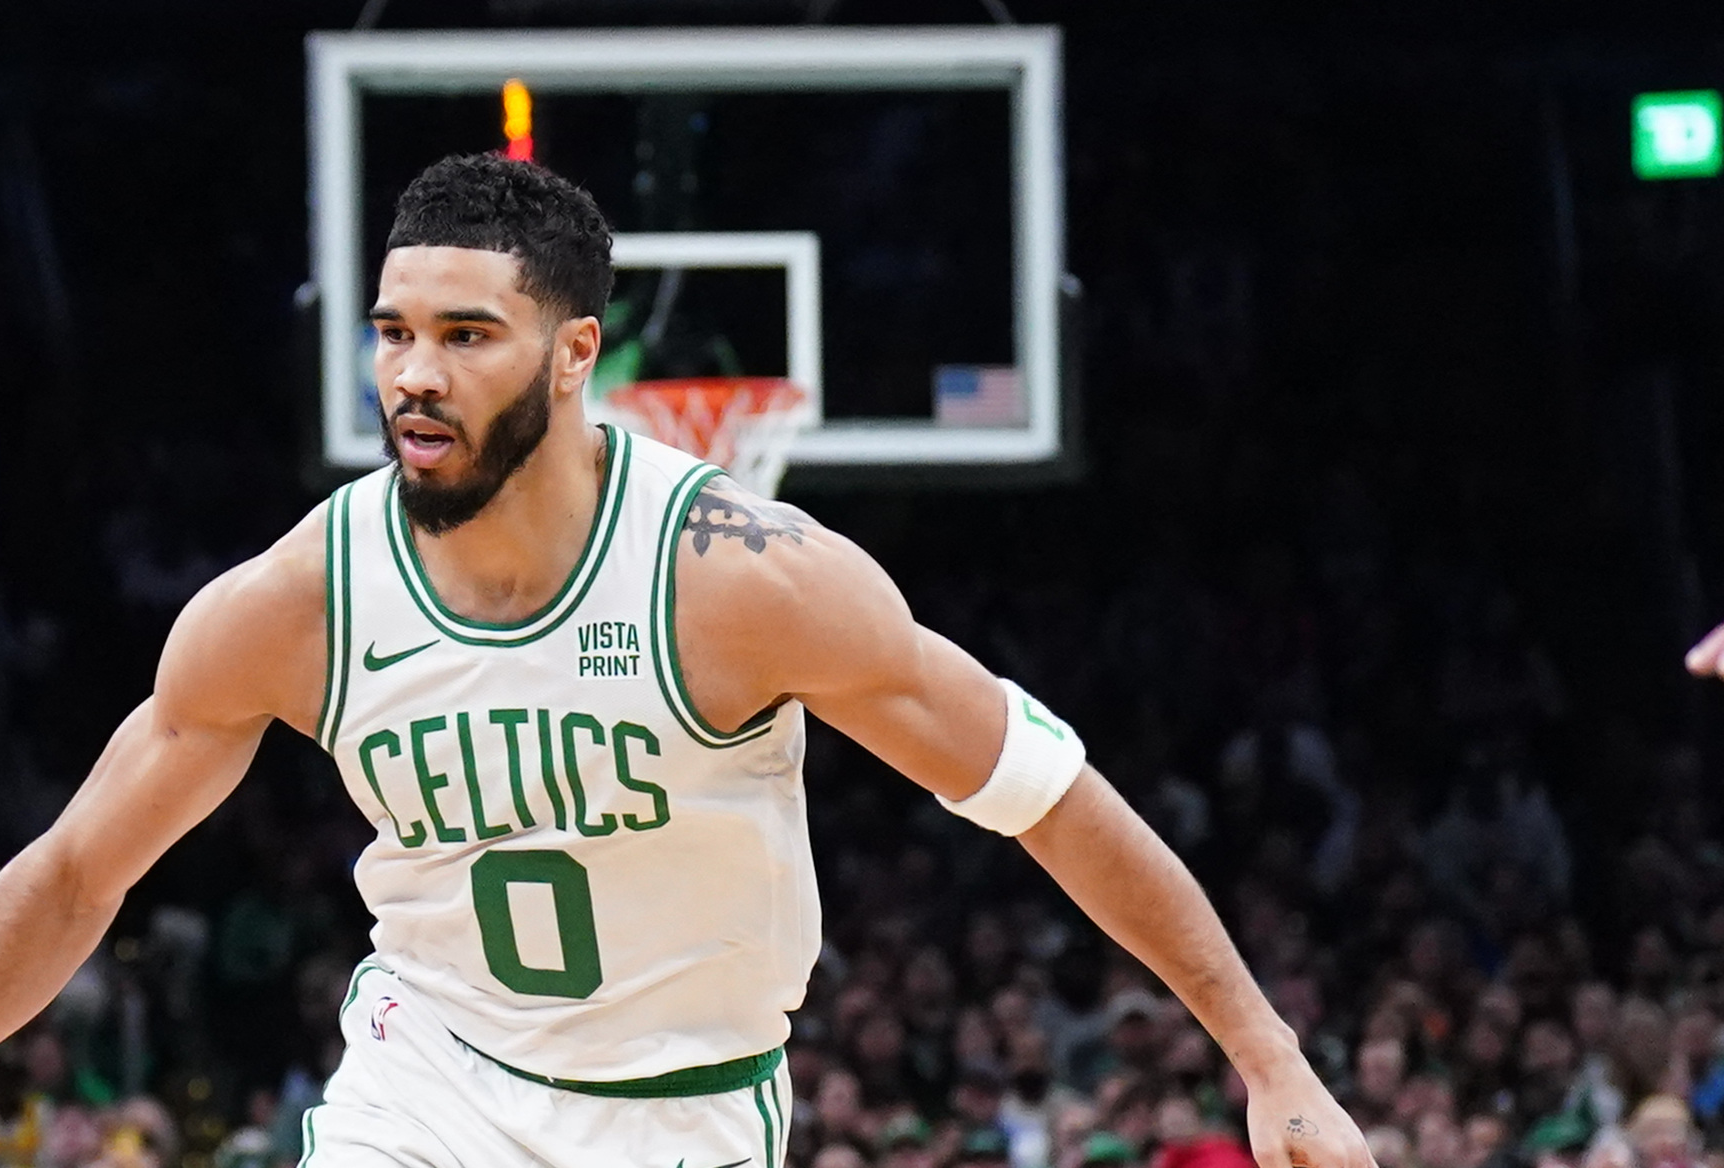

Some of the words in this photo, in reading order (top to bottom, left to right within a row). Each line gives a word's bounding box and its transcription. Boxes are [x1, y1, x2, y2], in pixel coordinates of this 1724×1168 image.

[578, 621, 640, 652] VISTA
[579, 655, 640, 677] PRINT
[358, 708, 671, 848] CELTICS
[470, 849, 603, 999] 0
